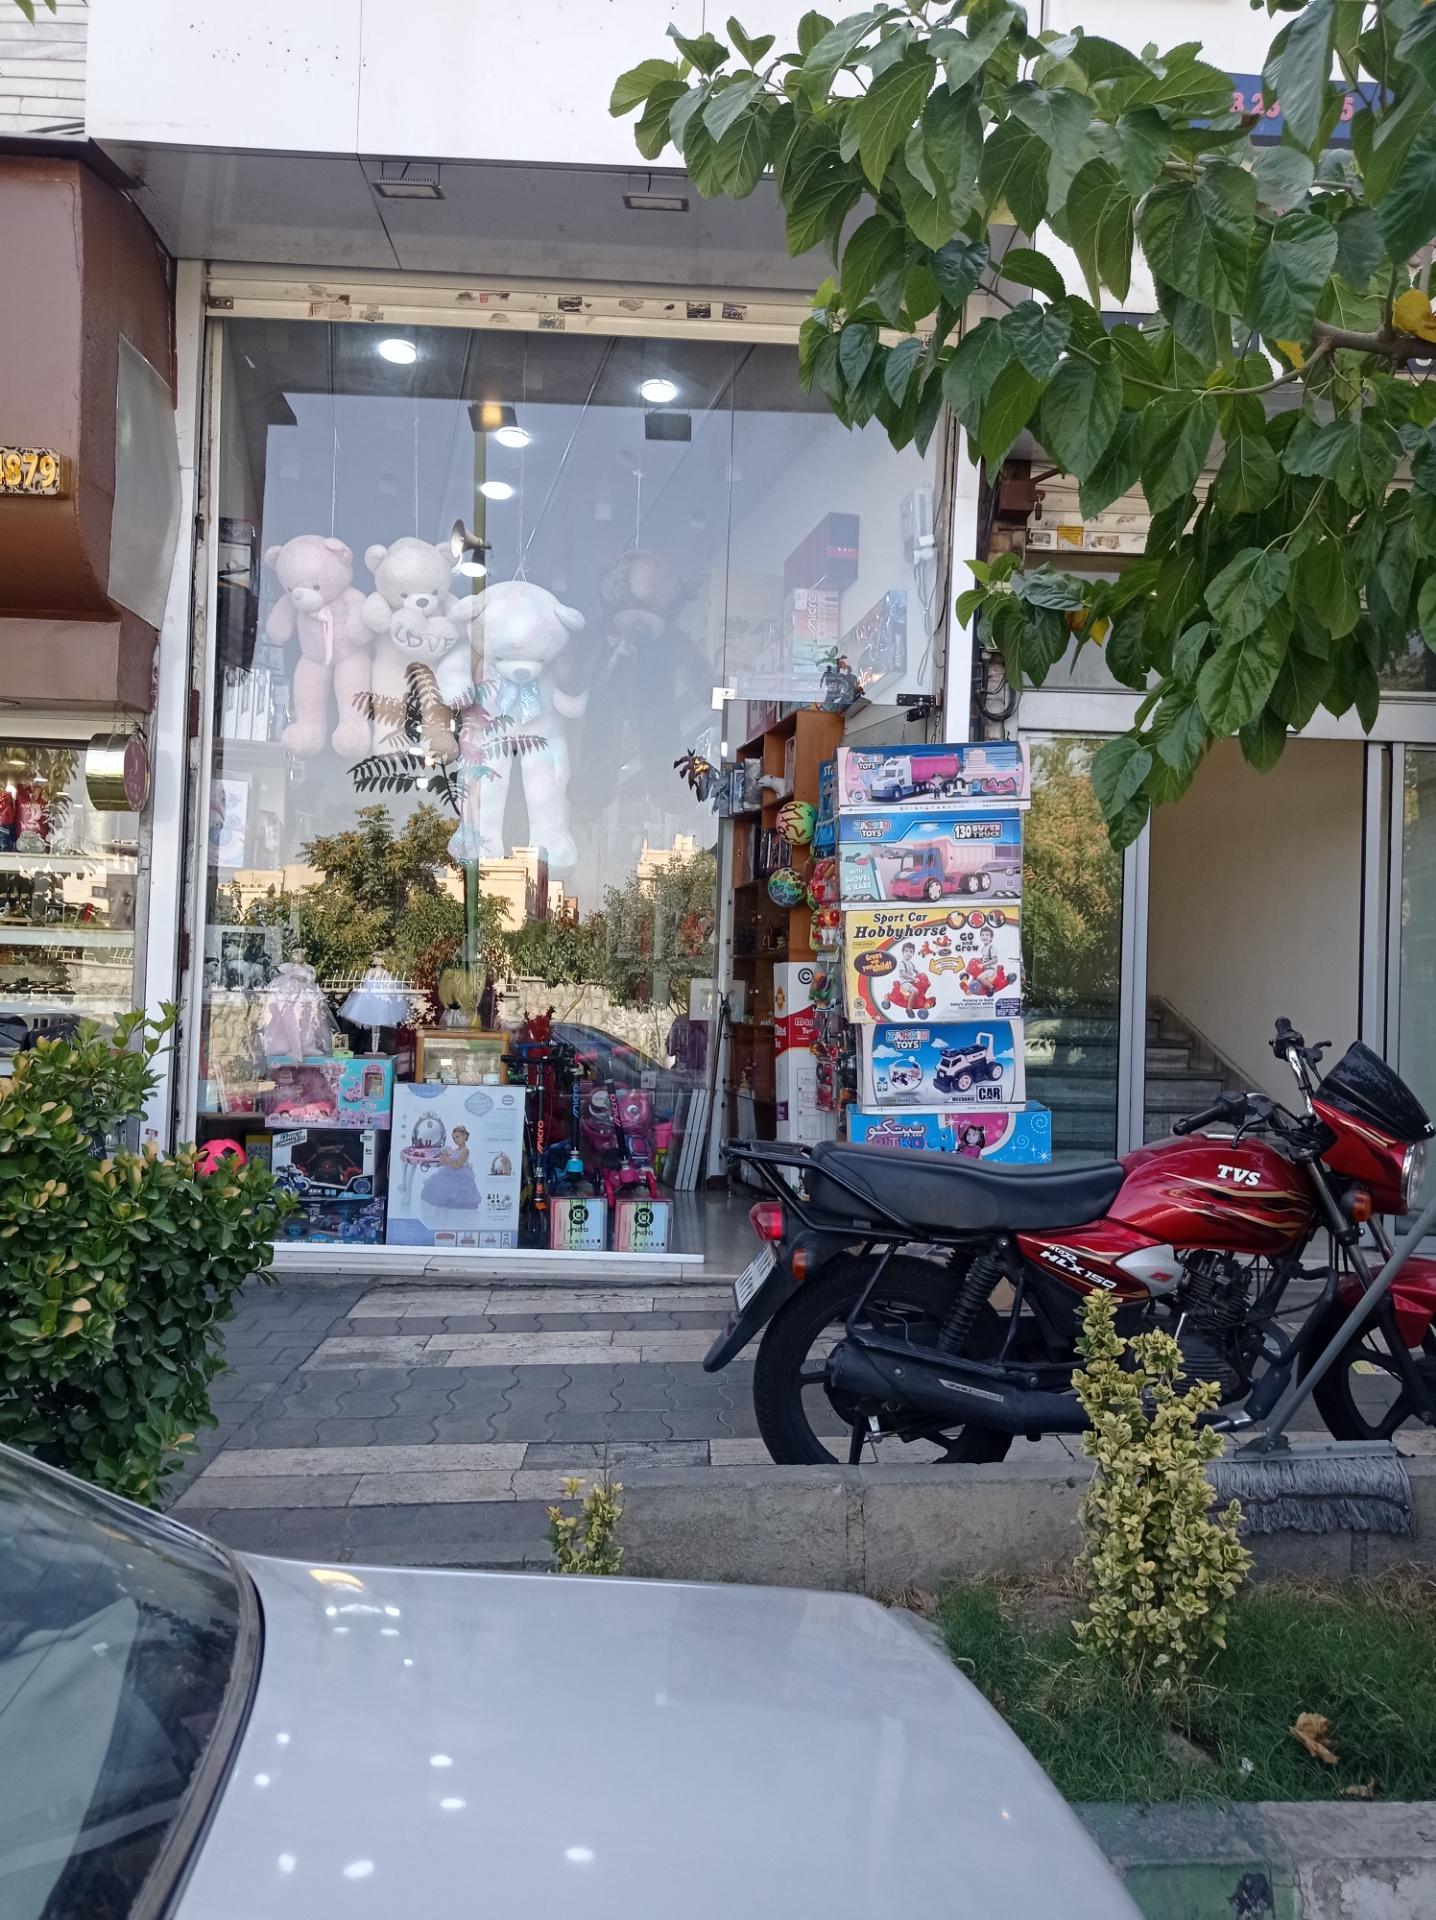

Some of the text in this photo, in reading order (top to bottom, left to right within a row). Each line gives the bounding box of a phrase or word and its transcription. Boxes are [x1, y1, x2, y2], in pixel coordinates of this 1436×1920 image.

[954, 825, 972, 839] 130
[873, 912, 928, 924] Sport Car
[853, 924, 947, 940] Hobbyhorse
[960, 932, 974, 941] GO
[896, 1040, 919, 1049] TOYS
[978, 1087, 1000, 1101] CAR
[609, 1093, 622, 1128] micro
[536, 1119, 545, 1154] micro
[1216, 1164, 1261, 1186] TVS
[1040, 1250, 1118, 1289] HLX 150
